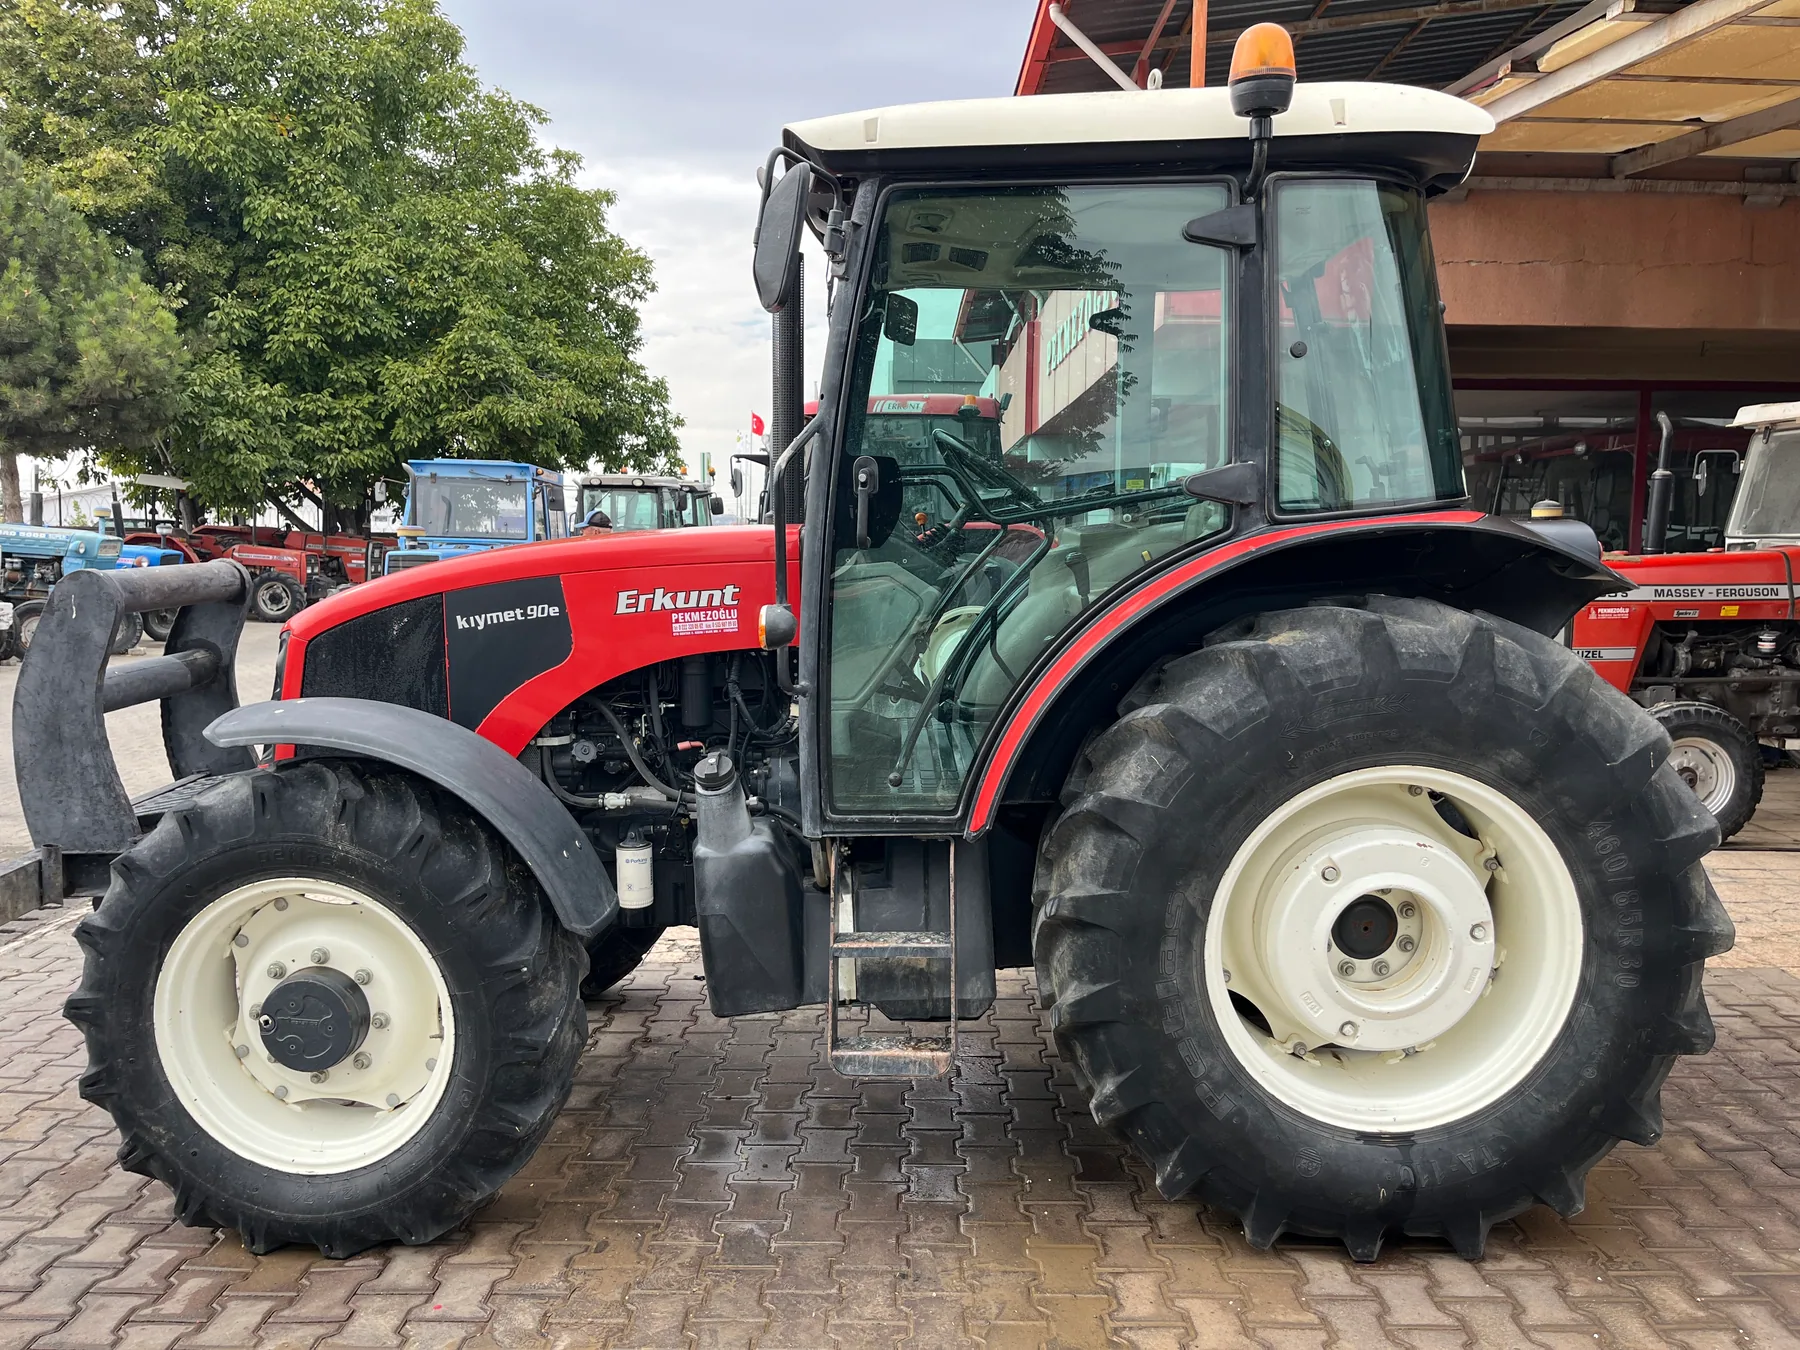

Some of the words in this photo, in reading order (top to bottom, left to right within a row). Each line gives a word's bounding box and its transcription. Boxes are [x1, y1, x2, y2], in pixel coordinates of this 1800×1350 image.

[614, 584, 741, 616] Erkunt
[1654, 588, 1705, 598] MASSEY
[1715, 587, 1779, 598] FERGUSON
[456, 608, 525, 630] kıymet
[527, 604, 560, 619] 90e
[671, 608, 738, 623] PEKMEZOĞLU
